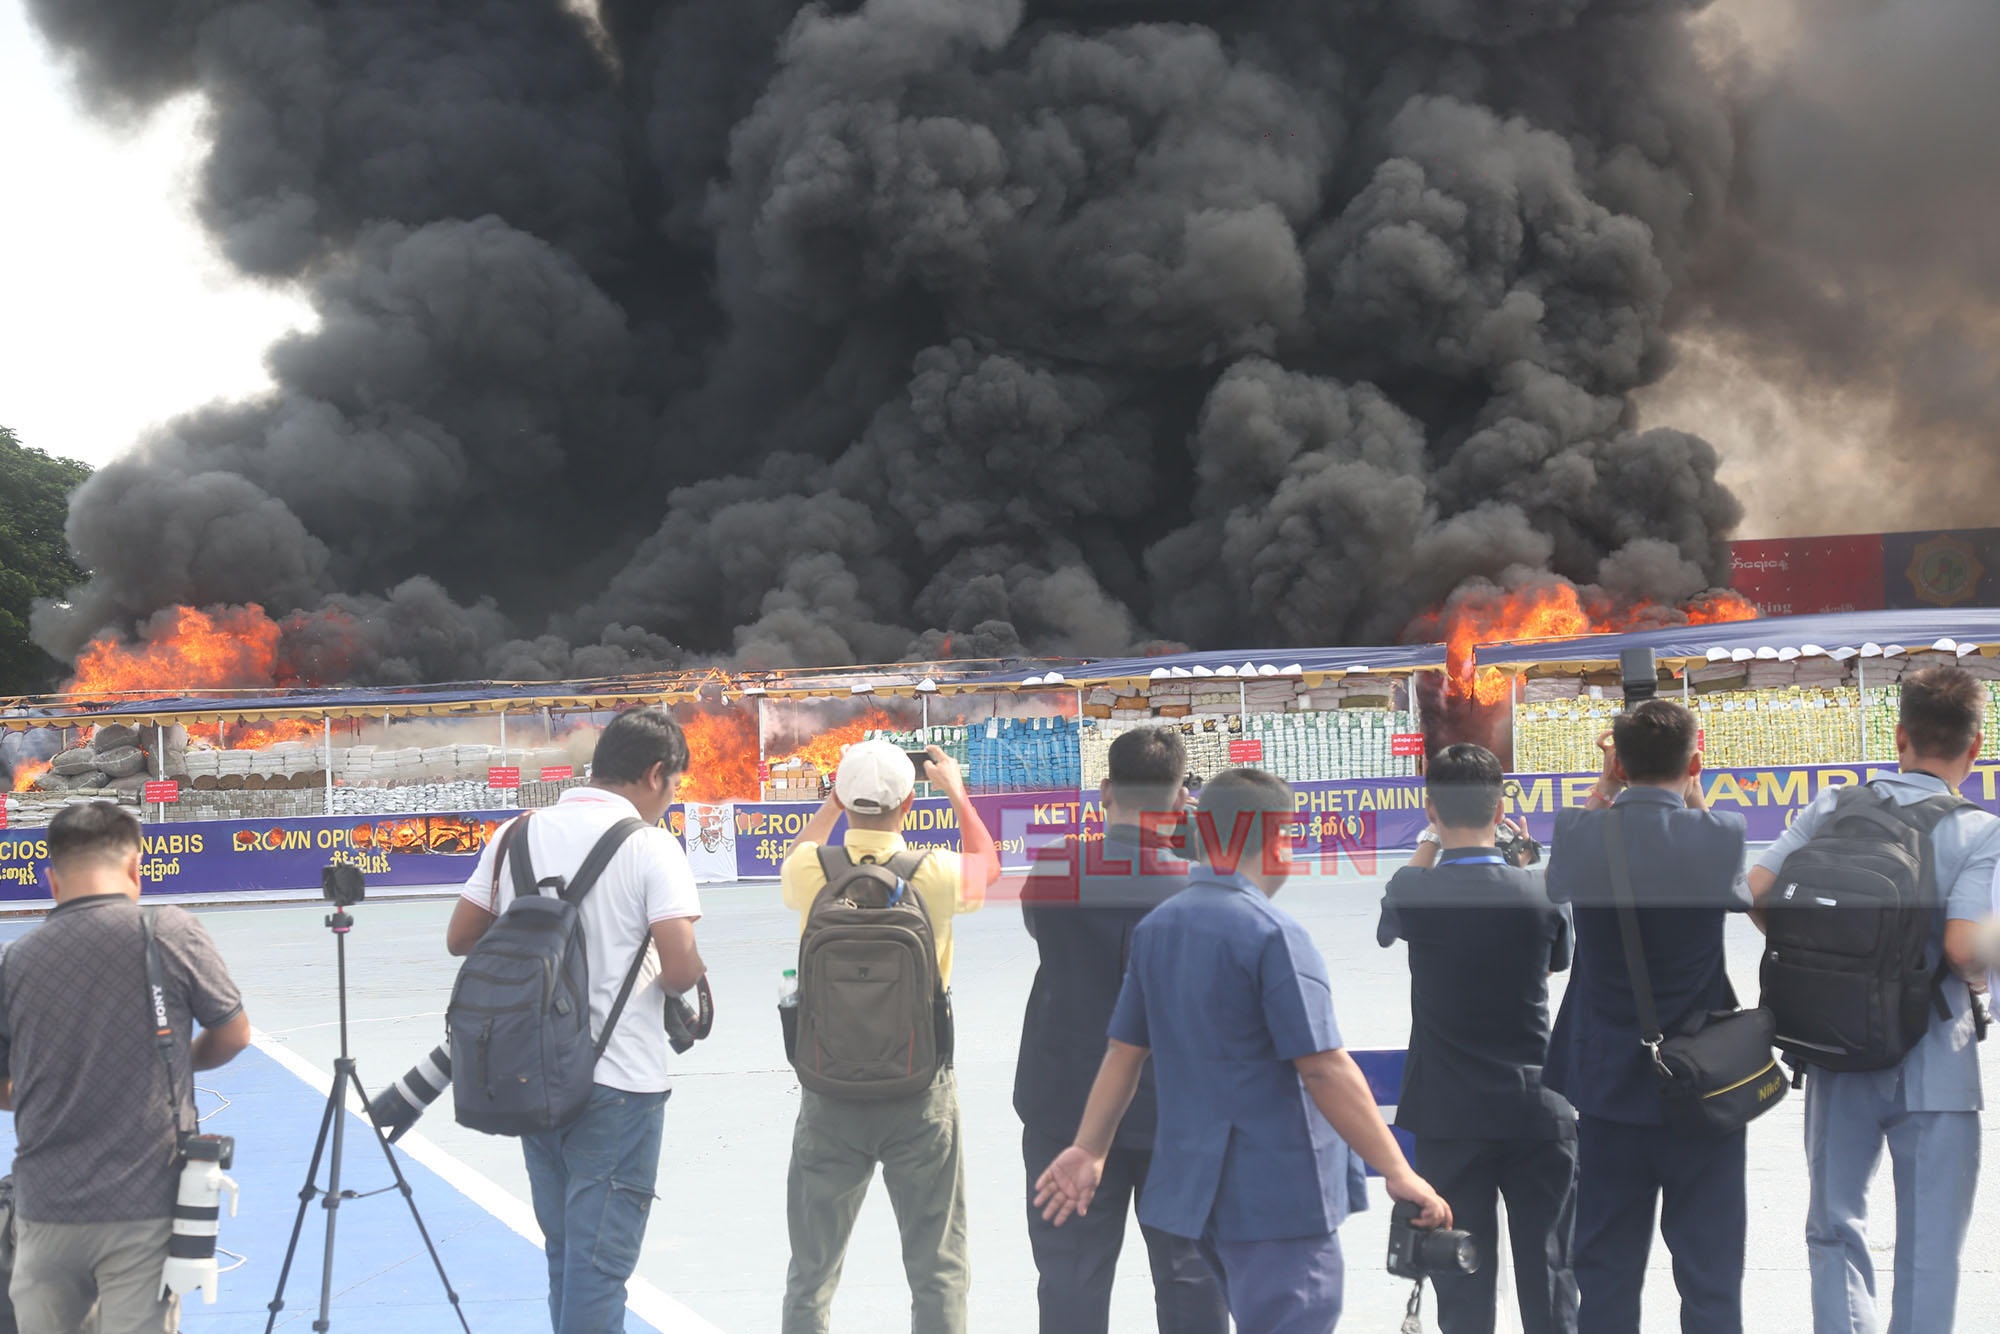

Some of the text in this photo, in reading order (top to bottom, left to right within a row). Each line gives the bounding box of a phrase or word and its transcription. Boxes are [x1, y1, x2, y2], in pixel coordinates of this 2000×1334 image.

[901, 807, 960, 831] MDM
[0, 834, 204, 861] CIOS NABIS
